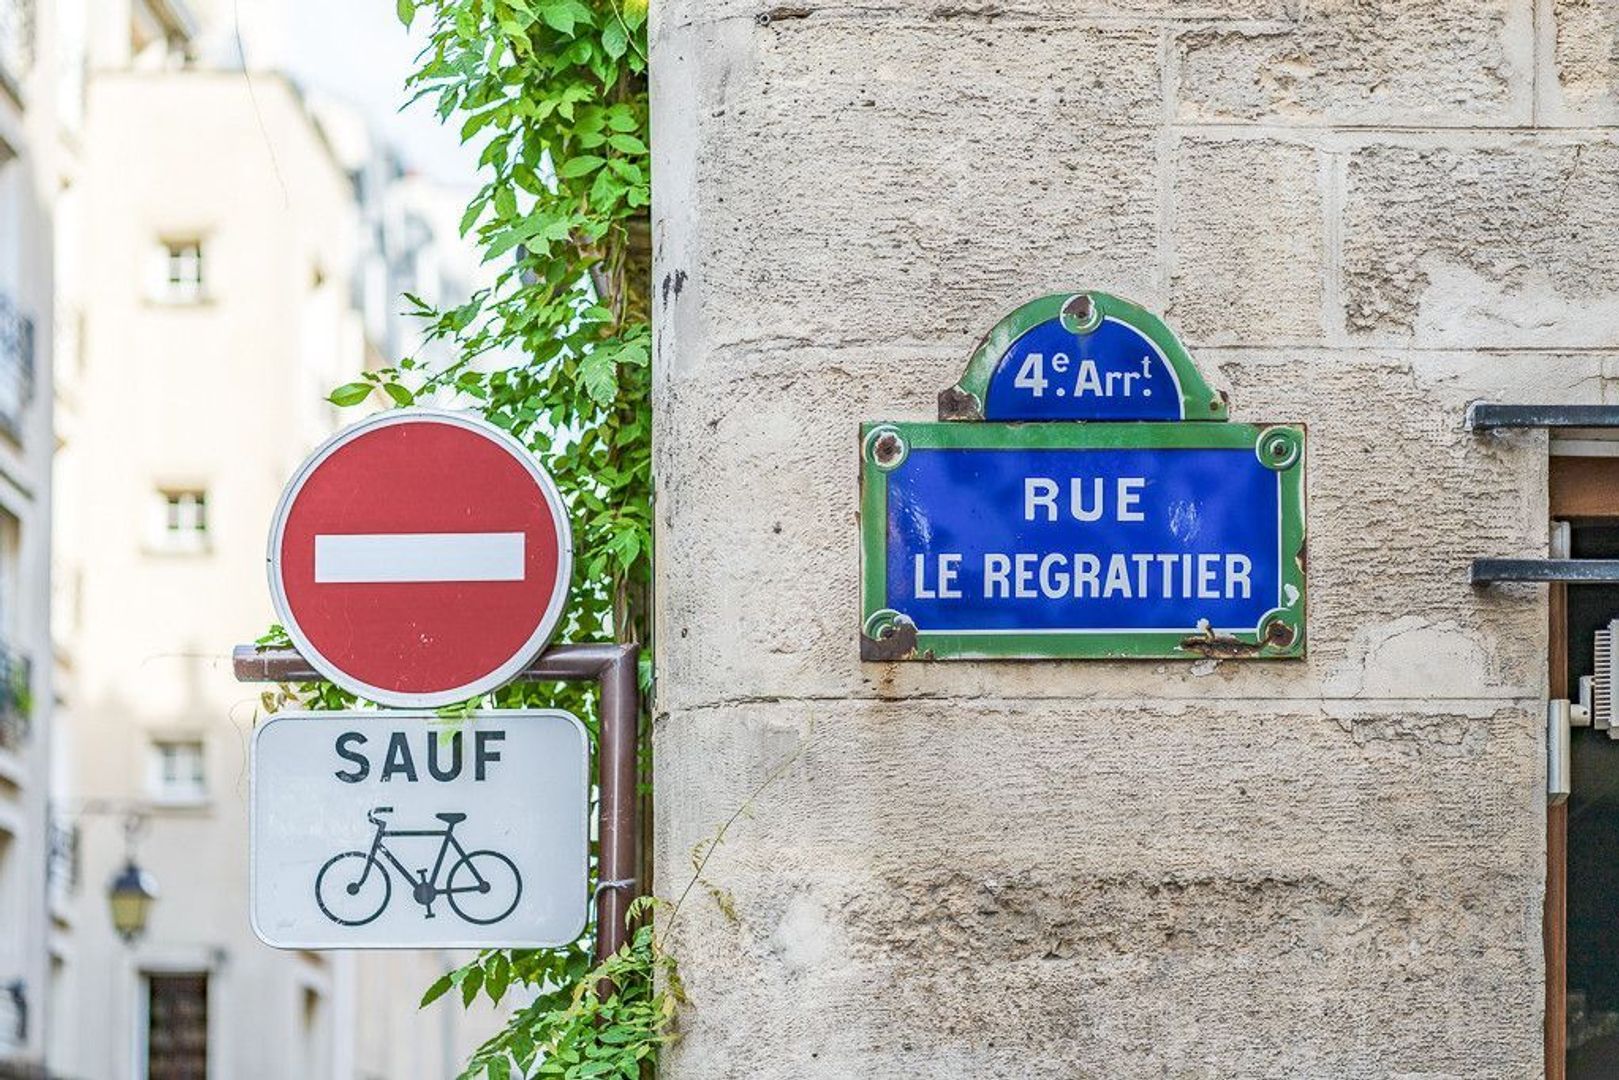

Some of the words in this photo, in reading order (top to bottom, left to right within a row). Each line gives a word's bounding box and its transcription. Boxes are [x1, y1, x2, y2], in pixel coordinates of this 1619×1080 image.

[1024, 477, 1146, 522] RUE
[914, 553, 962, 599] LE
[983, 553, 1252, 599] REGRATTIER
[334, 731, 506, 783] SAUF
